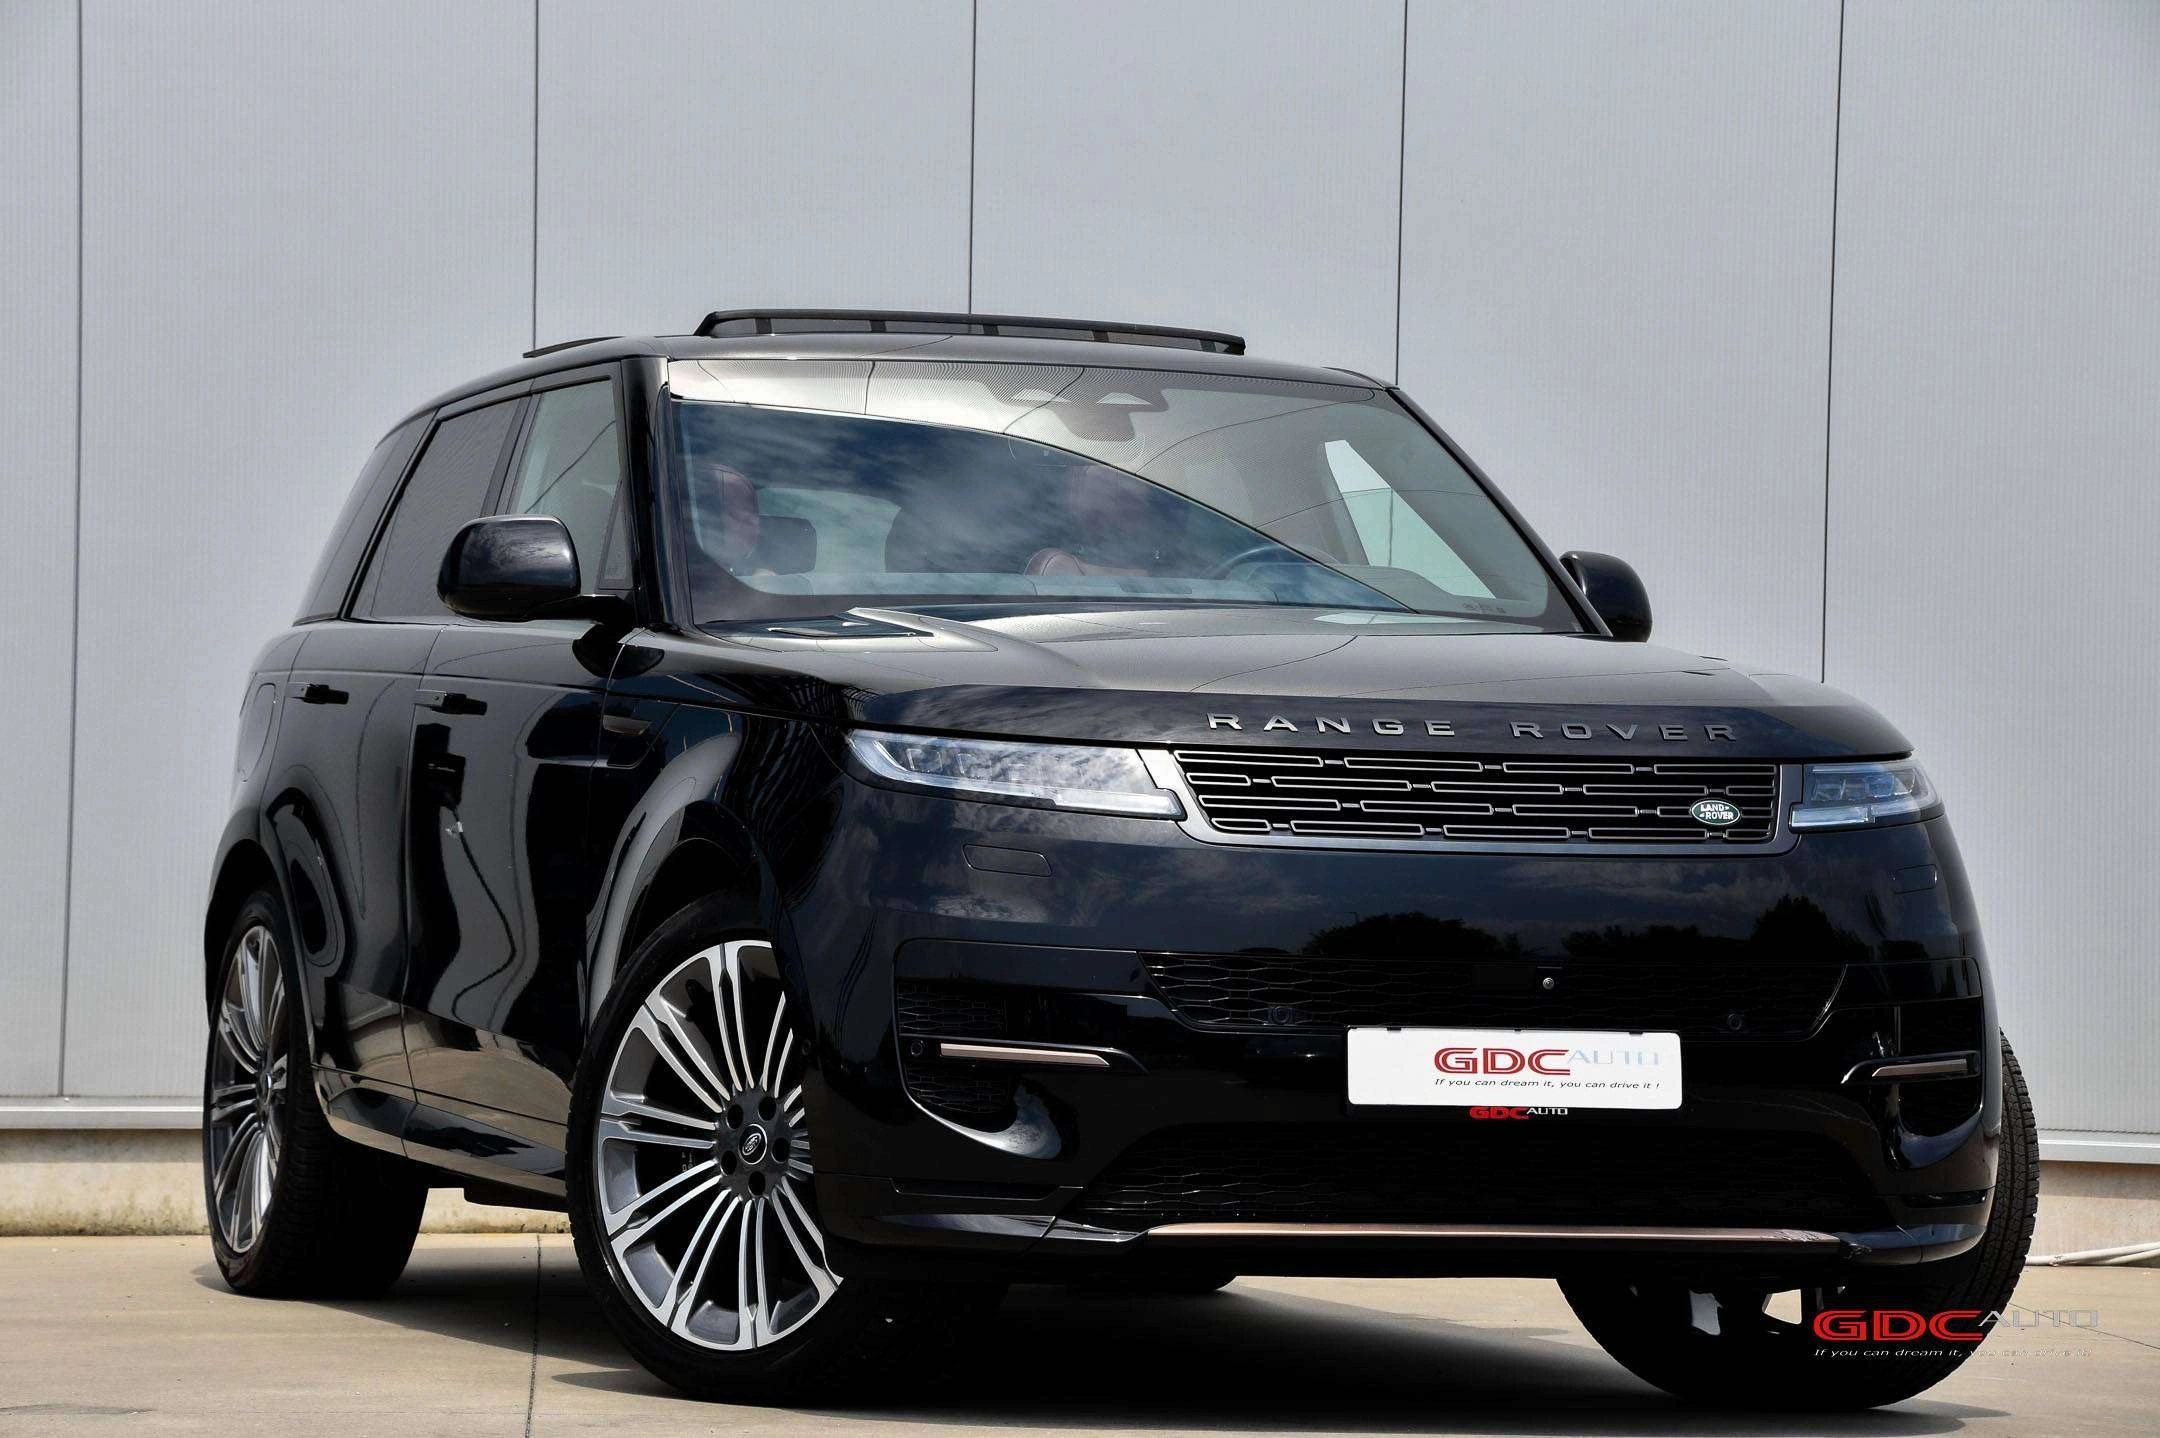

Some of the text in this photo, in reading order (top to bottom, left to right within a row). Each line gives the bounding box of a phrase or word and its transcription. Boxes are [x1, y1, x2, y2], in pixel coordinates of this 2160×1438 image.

[1207, 712, 1738, 742] RANGE ROVER
[1700, 803, 1725, 812] LAND
[1705, 811, 1734, 820] ROVER
[1434, 1078, 1445, 1086] If
[1543, 1080, 1555, 1088] it,
[1560, 1081, 1582, 1089] you
